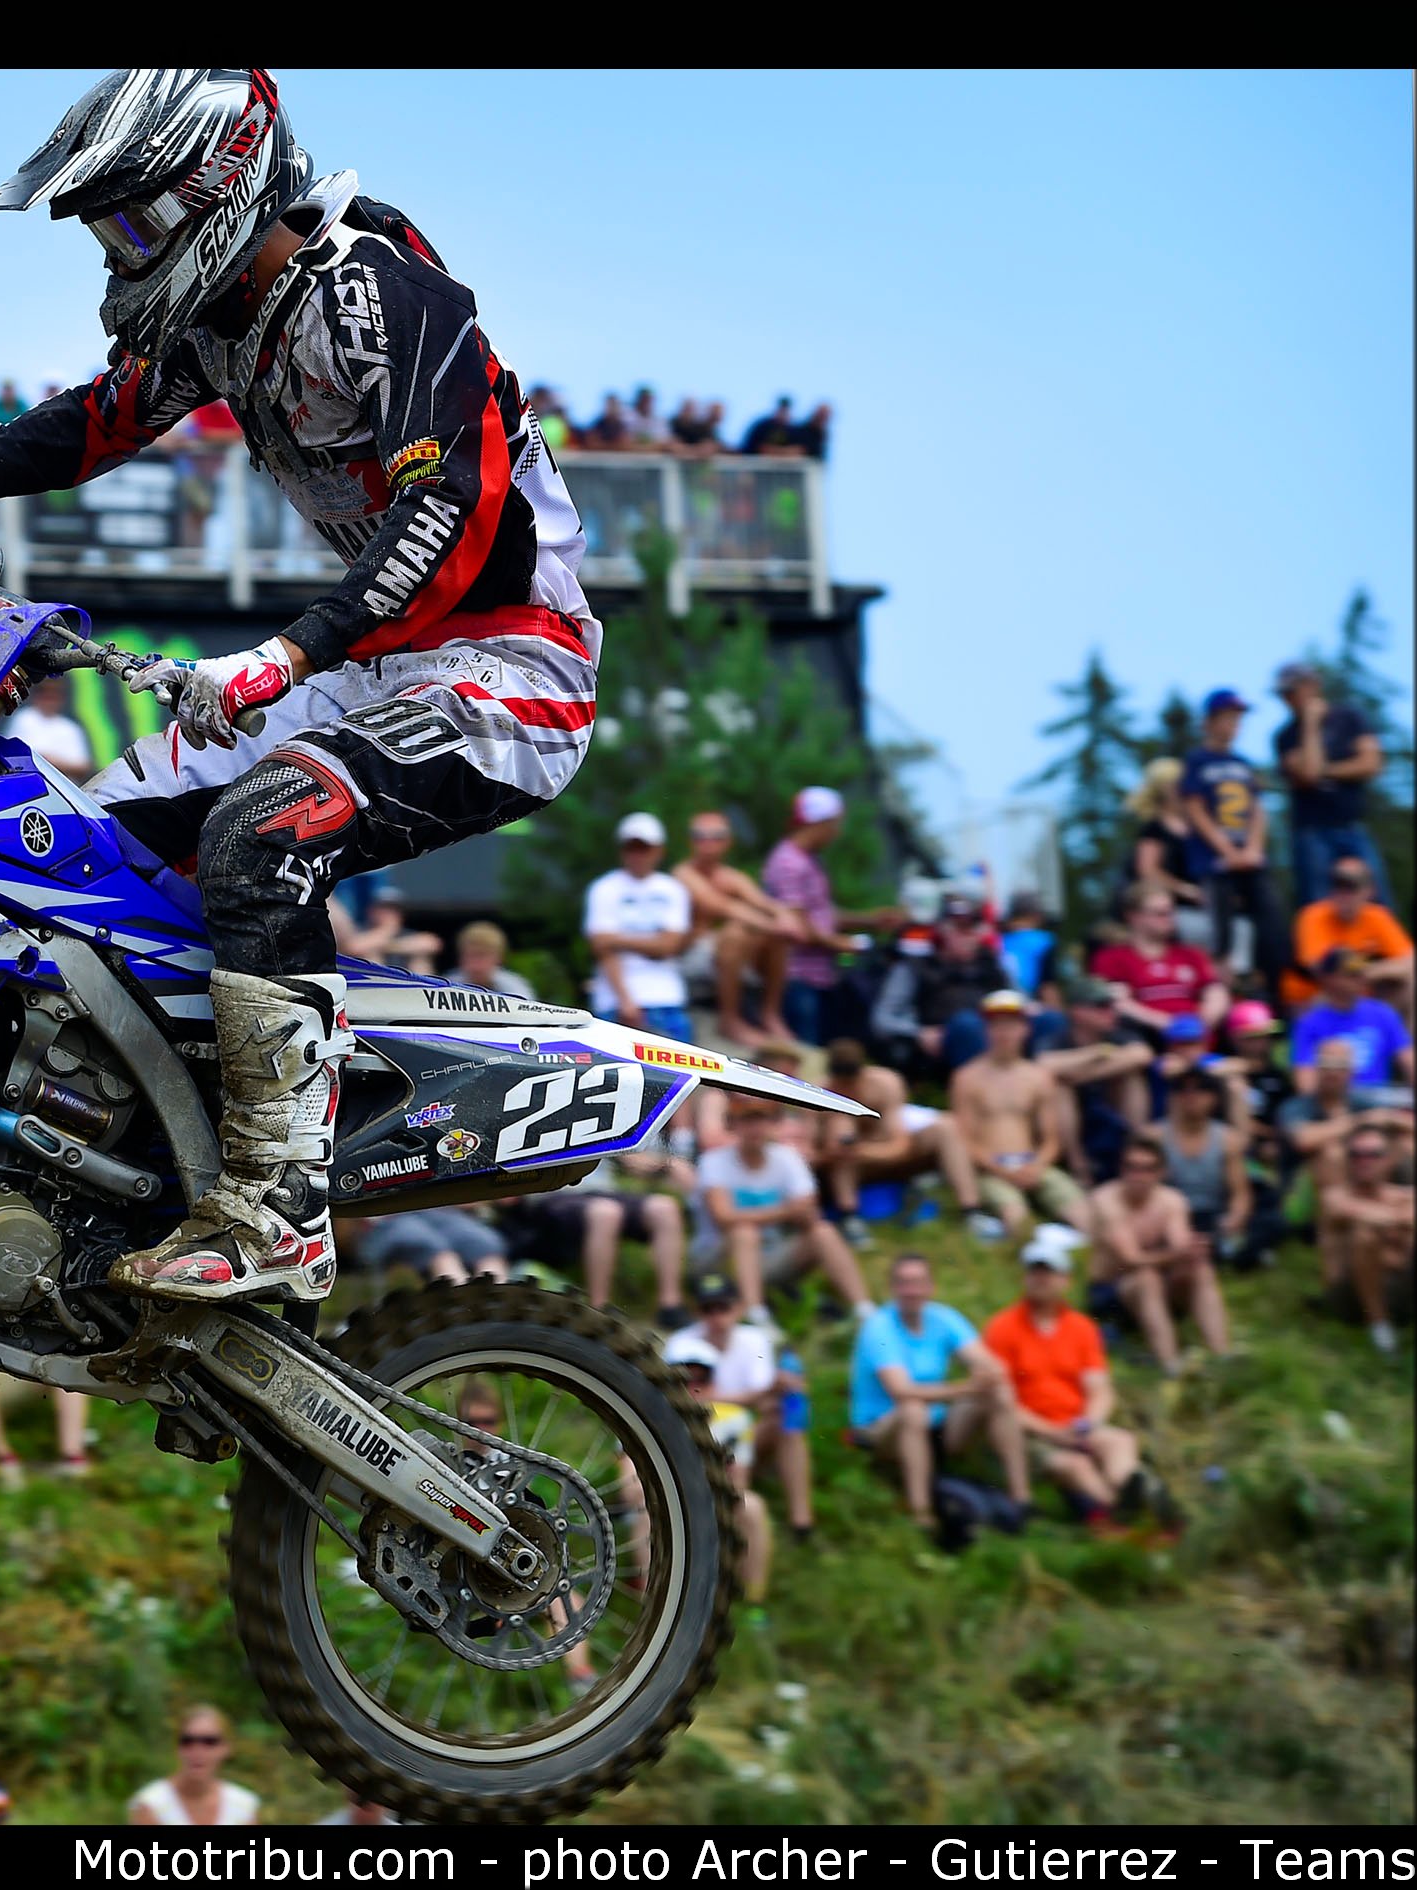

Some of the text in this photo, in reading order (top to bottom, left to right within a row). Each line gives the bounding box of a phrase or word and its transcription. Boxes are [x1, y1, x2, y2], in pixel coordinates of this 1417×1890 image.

[423, 989, 511, 1013] YAMAHA
[632, 1042, 723, 1073] PIRELLI
[406, 1105, 454, 1126] VERTEX
[495, 1062, 646, 1164] 23
[361, 1154, 430, 1182] YAMALUBE
[289, 1381, 403, 1477] YAMALUBE
